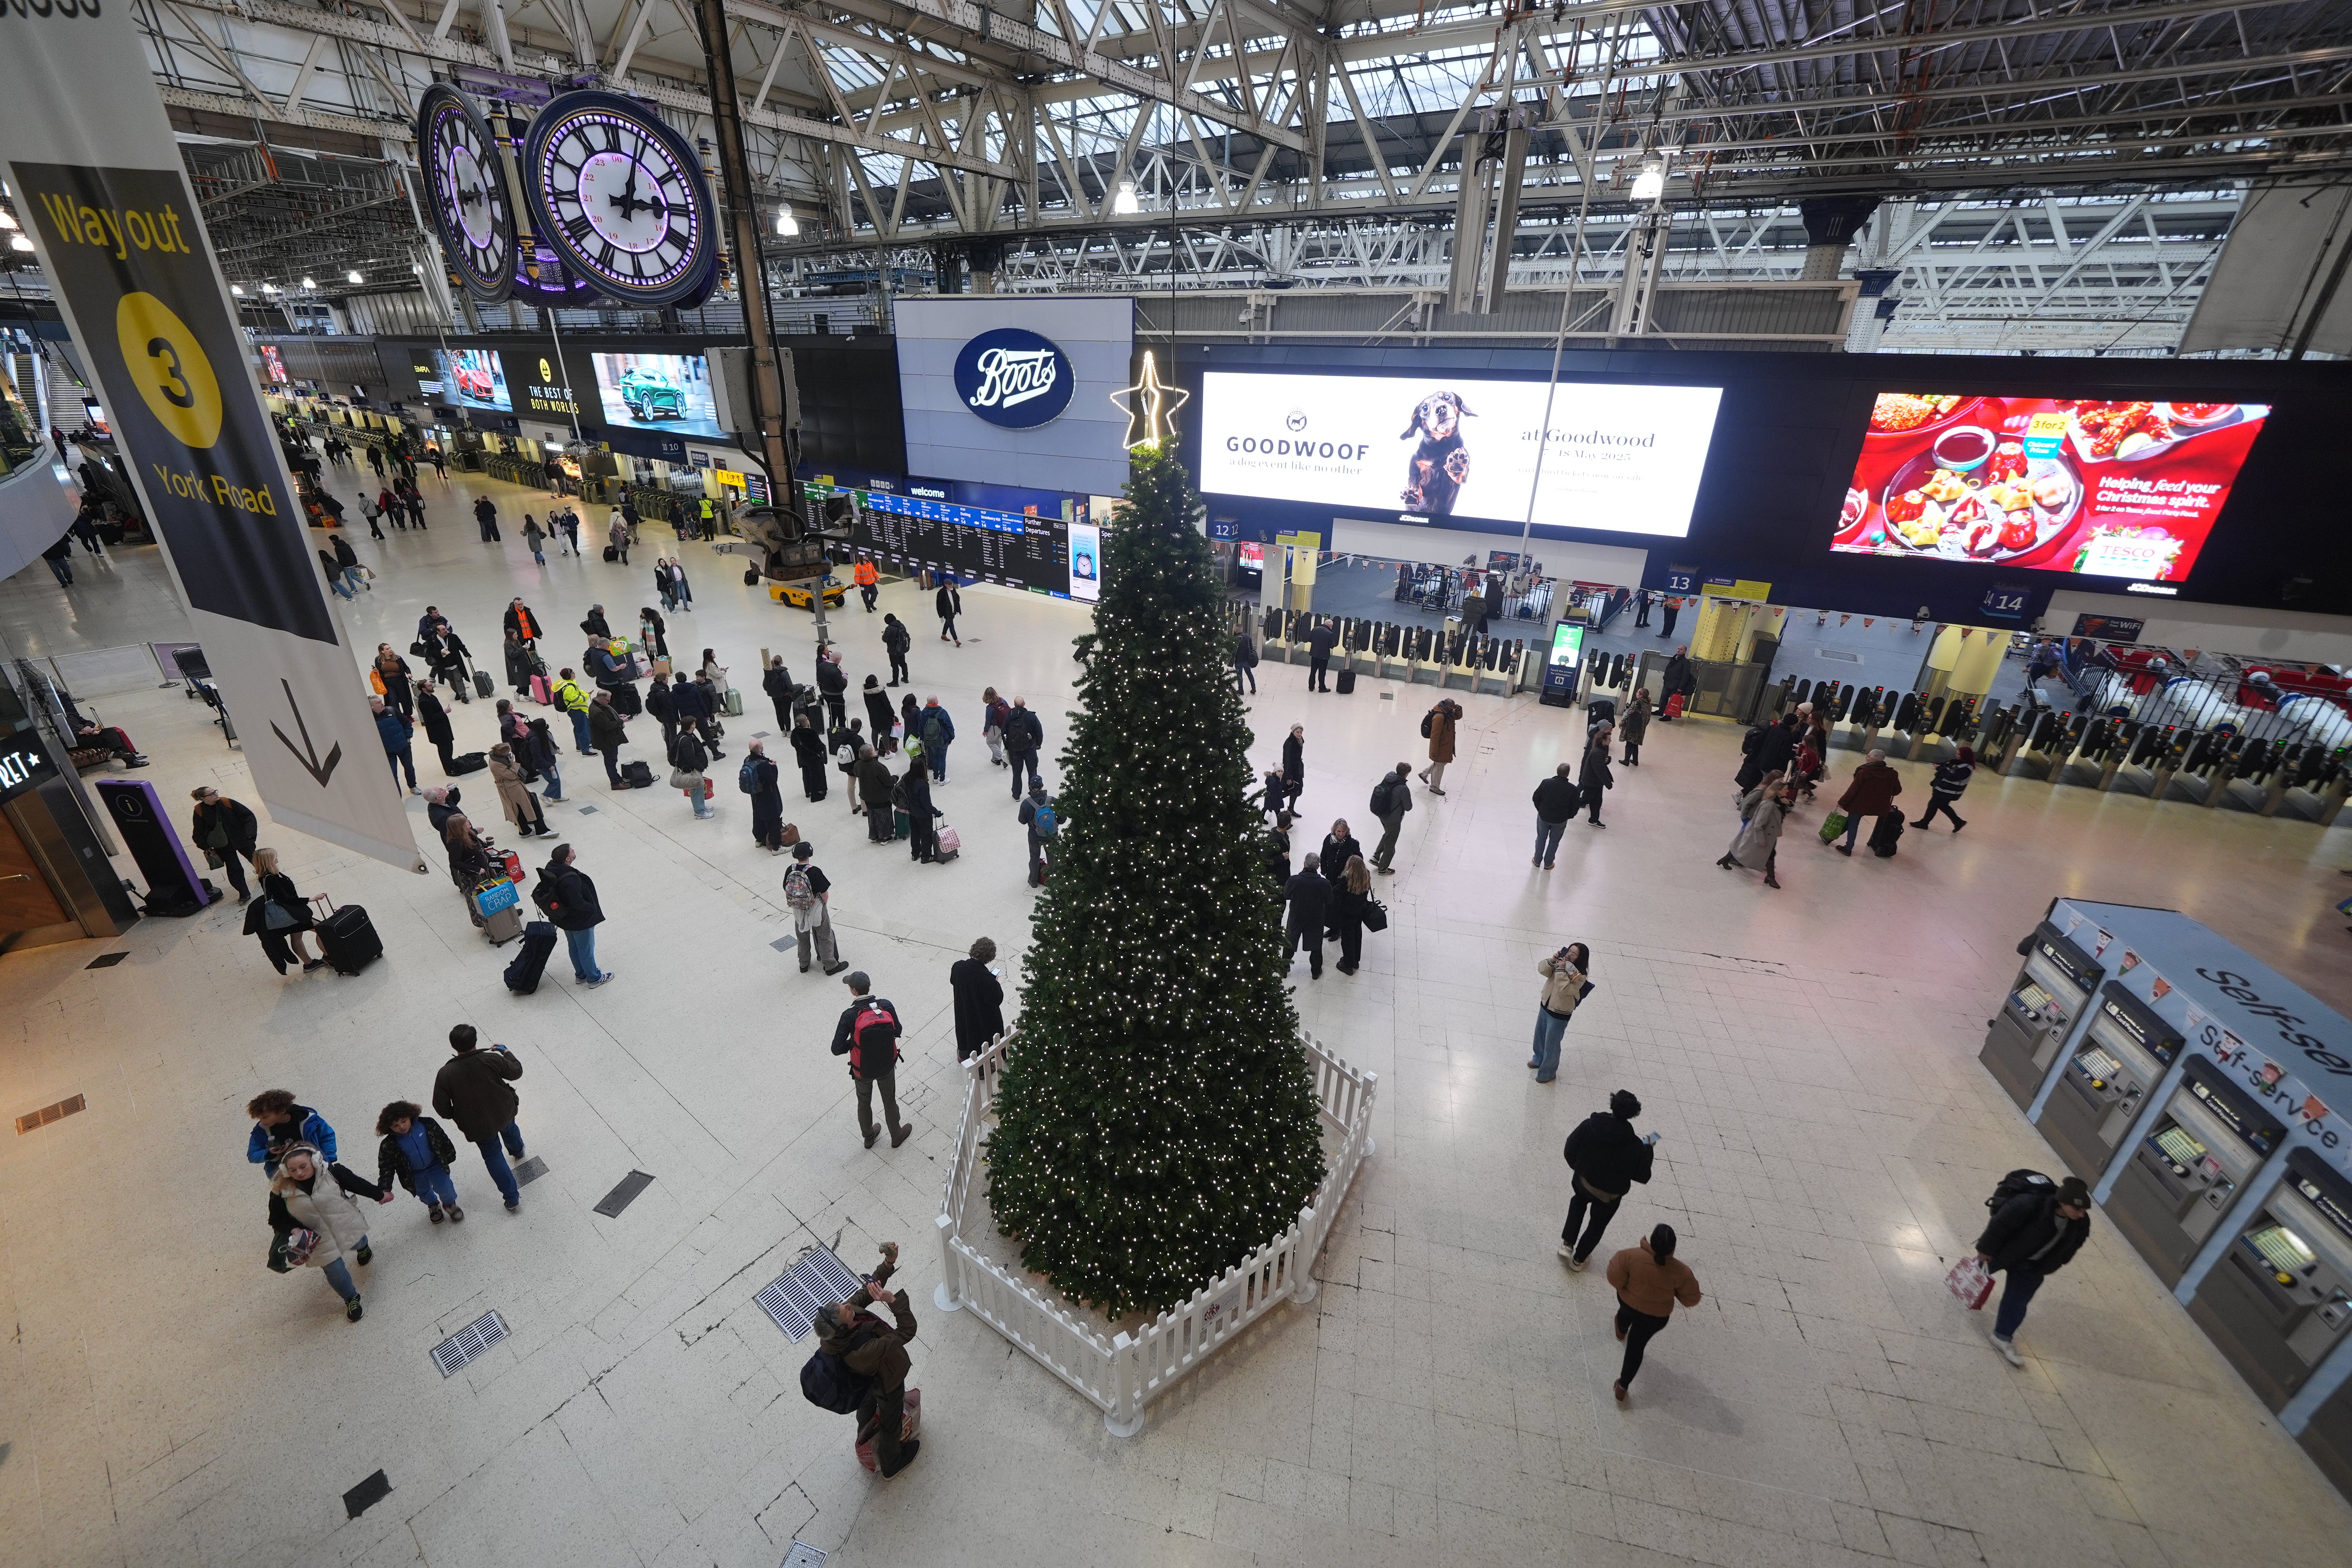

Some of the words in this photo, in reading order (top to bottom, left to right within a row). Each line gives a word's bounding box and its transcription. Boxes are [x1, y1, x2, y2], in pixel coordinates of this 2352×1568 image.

[594, 158, 605, 167] 23
[612, 155, 622, 163] 00
[584, 173, 595, 181] 22
[648, 182, 657, 191] 14
[583, 194, 593, 203] 21
[40, 192, 127, 260] Way
[125, 203, 191, 255] out
[147, 337, 195, 408] 3
[969, 348, 1057, 409] Boots
[529, 386, 543, 397] THE
[544, 387, 561, 399] BEST
[530, 398, 549, 410] BOTH
[2041, 421, 2058, 429] for
[1522, 429, 1541, 441] at
[1545, 429, 1655, 447] Goodwood
[1227, 436, 1369, 461] GOODWOOF
[1573, 450, 1598, 461] May
[1601, 452, 1631, 461] 2025
[1238, 457, 1256, 468] dog
[1259, 460, 1288, 470] event
[1291, 461, 1311, 472] like
[1330, 465, 1363, 475] other
[152, 463, 210, 503] York
[210, 475, 277, 516] Road
[2098, 476, 2154, 492] Helping
[2149, 479, 2187, 493] feed
[2184, 483, 2222, 495] your
[911, 486, 945, 499] welcome
[2096, 490, 2167, 505] Christmas
[2167, 495, 2211, 508] spirit.
[1399, 515, 1429, 523] JCDecaux
[2162, 509, 2180, 517] Party
[1025, 518, 1042, 526] Further
[1025, 526, 1051, 536] Departures
[1216, 524, 1229, 536] 12
[1231, 524, 1239, 535] 12
[2102, 545, 2155, 557] TESCO
[1412, 571, 1424, 581] 12
[1669, 576, 1690, 590] 13
[2127, 583, 2178, 595] JCDecaux
[1983, 590, 1994, 606] 14
[1995, 595, 2023, 610] 14
[2120, 621, 2142, 630] WiFi
[485, 887, 510, 902] RANDOM
[488, 893, 512, 911] CRAP
[2052, 956, 2060, 965] Card
[2059, 962, 2074, 978] Payments
[2115, 1014, 2126, 1026] Card
[2125, 1022, 2146, 1044] Payments
[2200, 1024, 2339, 1149] Sef-servce
[2206, 1099, 2218, 1111] Card
[2216, 1108, 2241, 1132] Payments
[2316, 1200, 2331, 1215] Card
